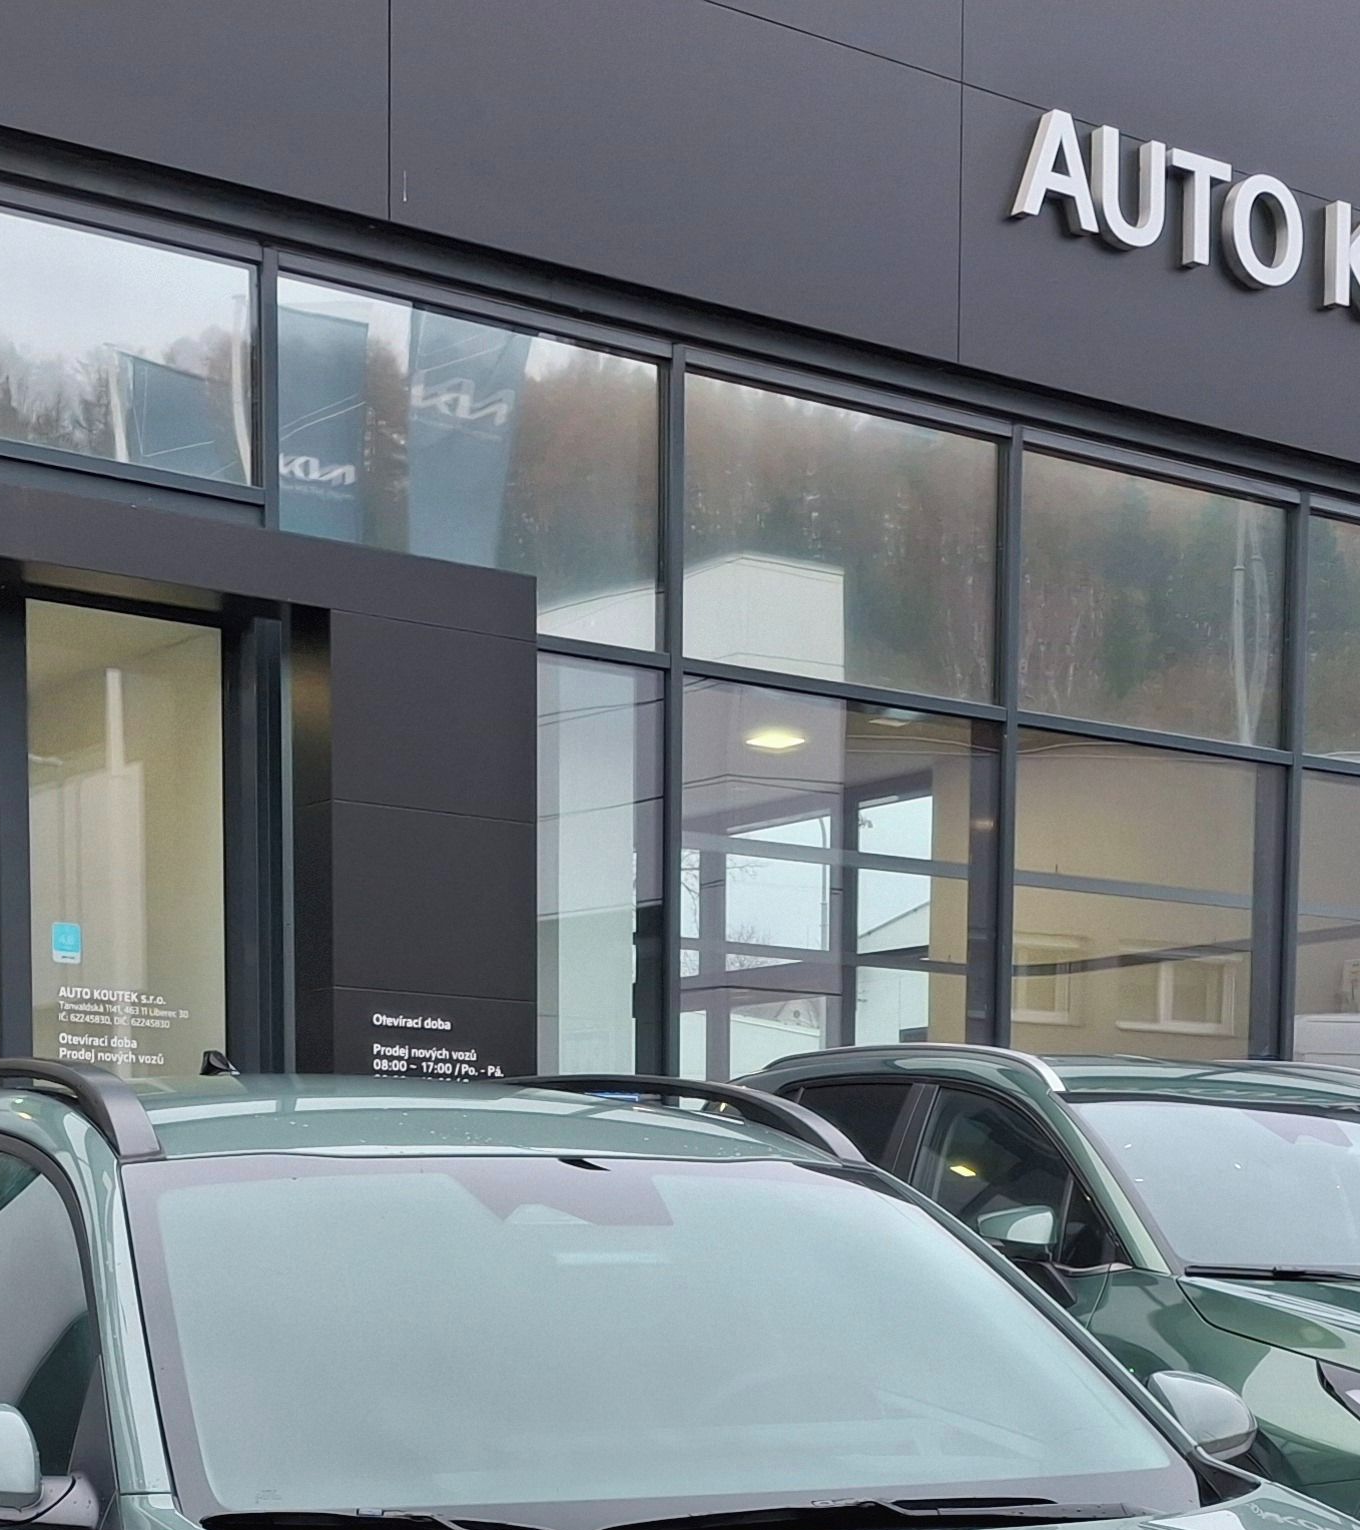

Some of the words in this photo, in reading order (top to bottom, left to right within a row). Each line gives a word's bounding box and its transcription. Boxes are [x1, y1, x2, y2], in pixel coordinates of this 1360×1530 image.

[1009, 108, 1303, 290] AUTO
[59, 986, 91, 1000] AUTO
[93, 989, 139, 1003] KOUTEK
[140, 994, 167, 1005] s.r.o.
[372, 1013, 423, 1029] Otevírací
[424, 1017, 452, 1031] doba
[59, 1033, 109, 1047] Otevírací
[110, 1036, 138, 1049] doba
[59, 1047, 96, 1063] Prodej
[97, 1051, 137, 1065] nových
[138, 1053, 165, 1065] vozů
[373, 1043, 409, 1060] Prodej
[411, 1047, 450, 1061] nových
[451, 1049, 478, 1061] vozů
[373, 1059, 408, 1072] 08:00
[421, 1062, 453, 1074] 17:00
